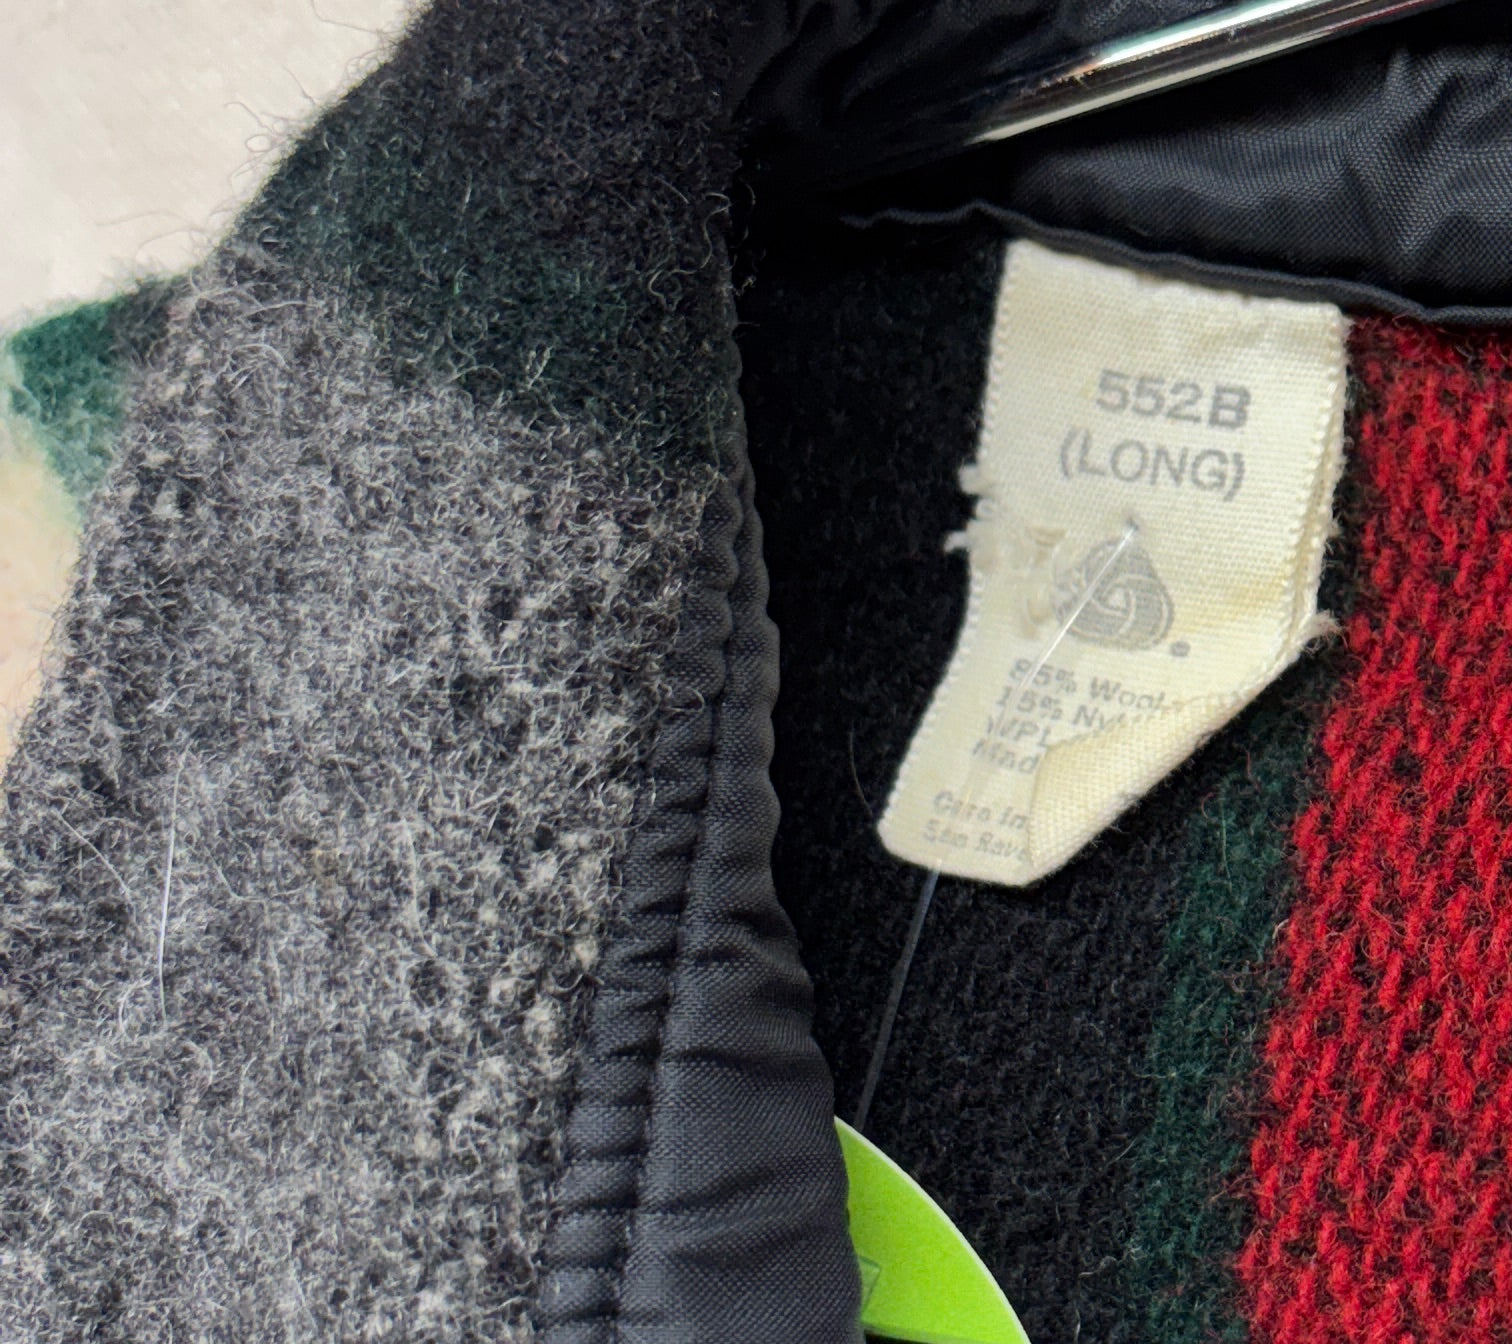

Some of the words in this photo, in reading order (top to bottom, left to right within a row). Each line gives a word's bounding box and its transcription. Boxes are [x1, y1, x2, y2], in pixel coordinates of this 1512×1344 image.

[1096, 369, 1251, 429] 552B
[1059, 427, 1245, 502] (LONG)
[1089, 676, 1166, 710] Wool
